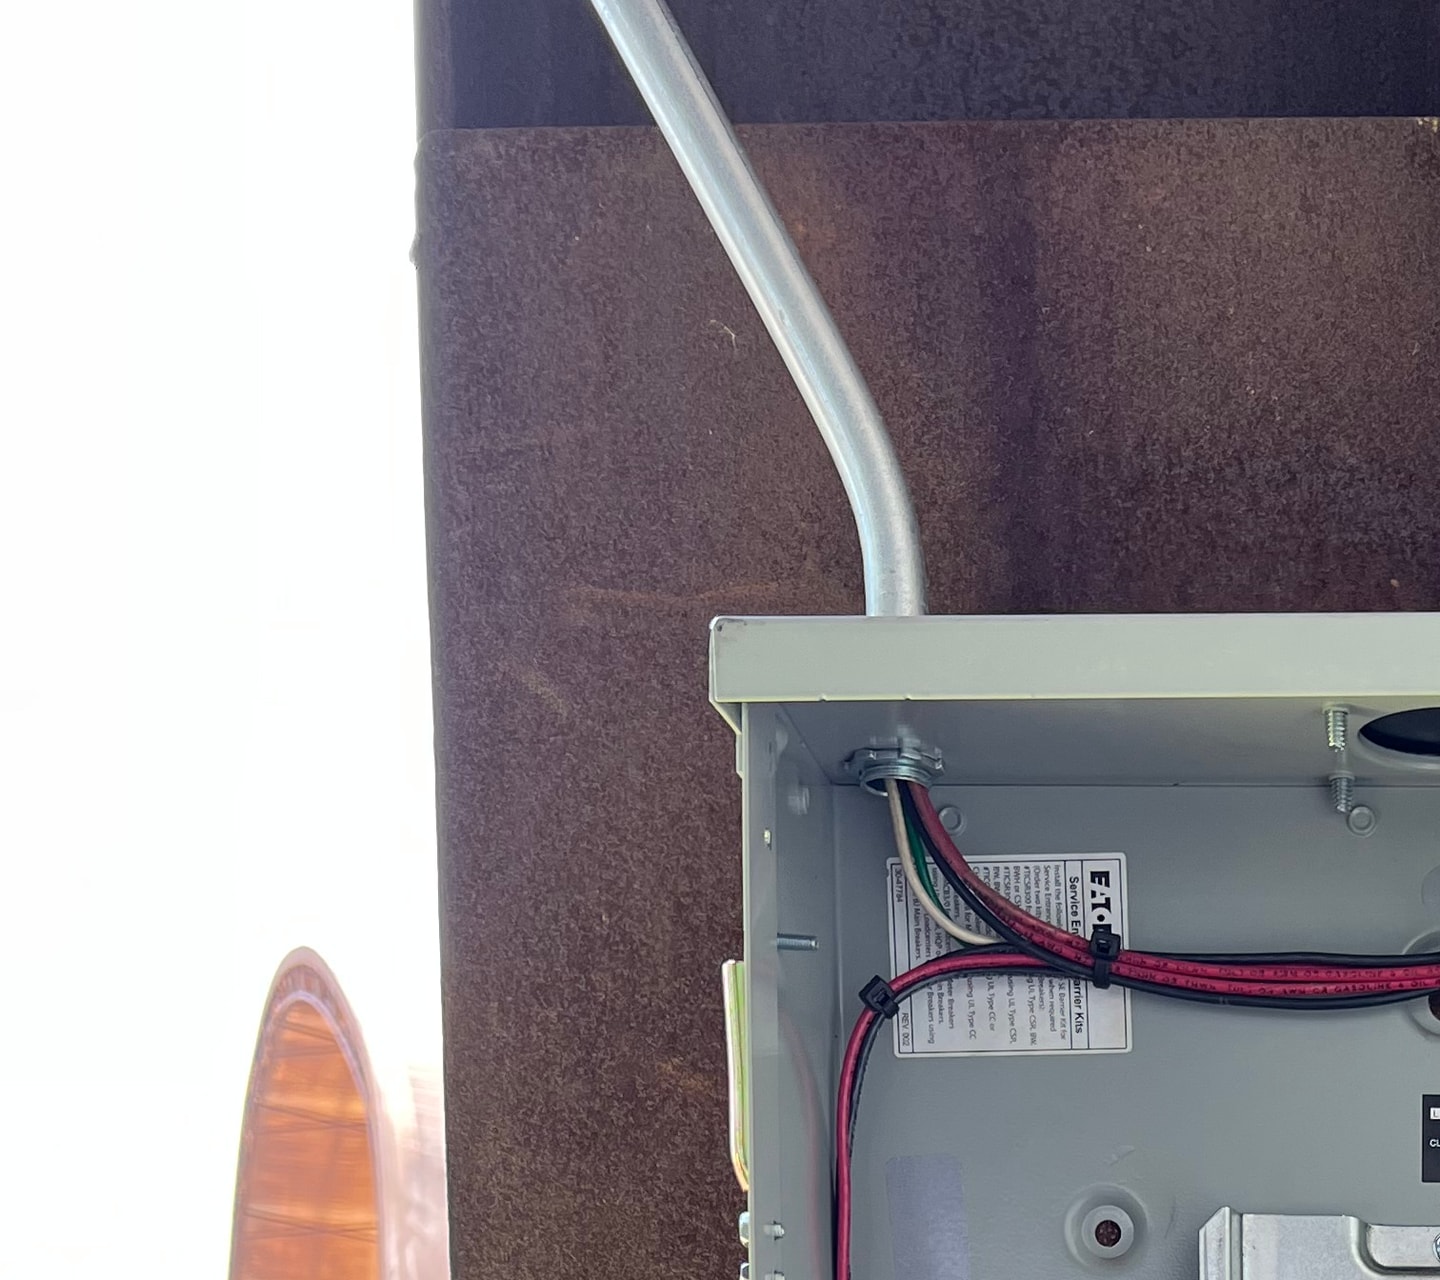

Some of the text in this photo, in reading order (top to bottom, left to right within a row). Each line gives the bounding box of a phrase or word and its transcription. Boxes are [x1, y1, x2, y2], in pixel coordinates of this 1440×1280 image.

[1069, 876, 1080, 917] Service
[1073, 979, 1085, 1034] arrier Kits
